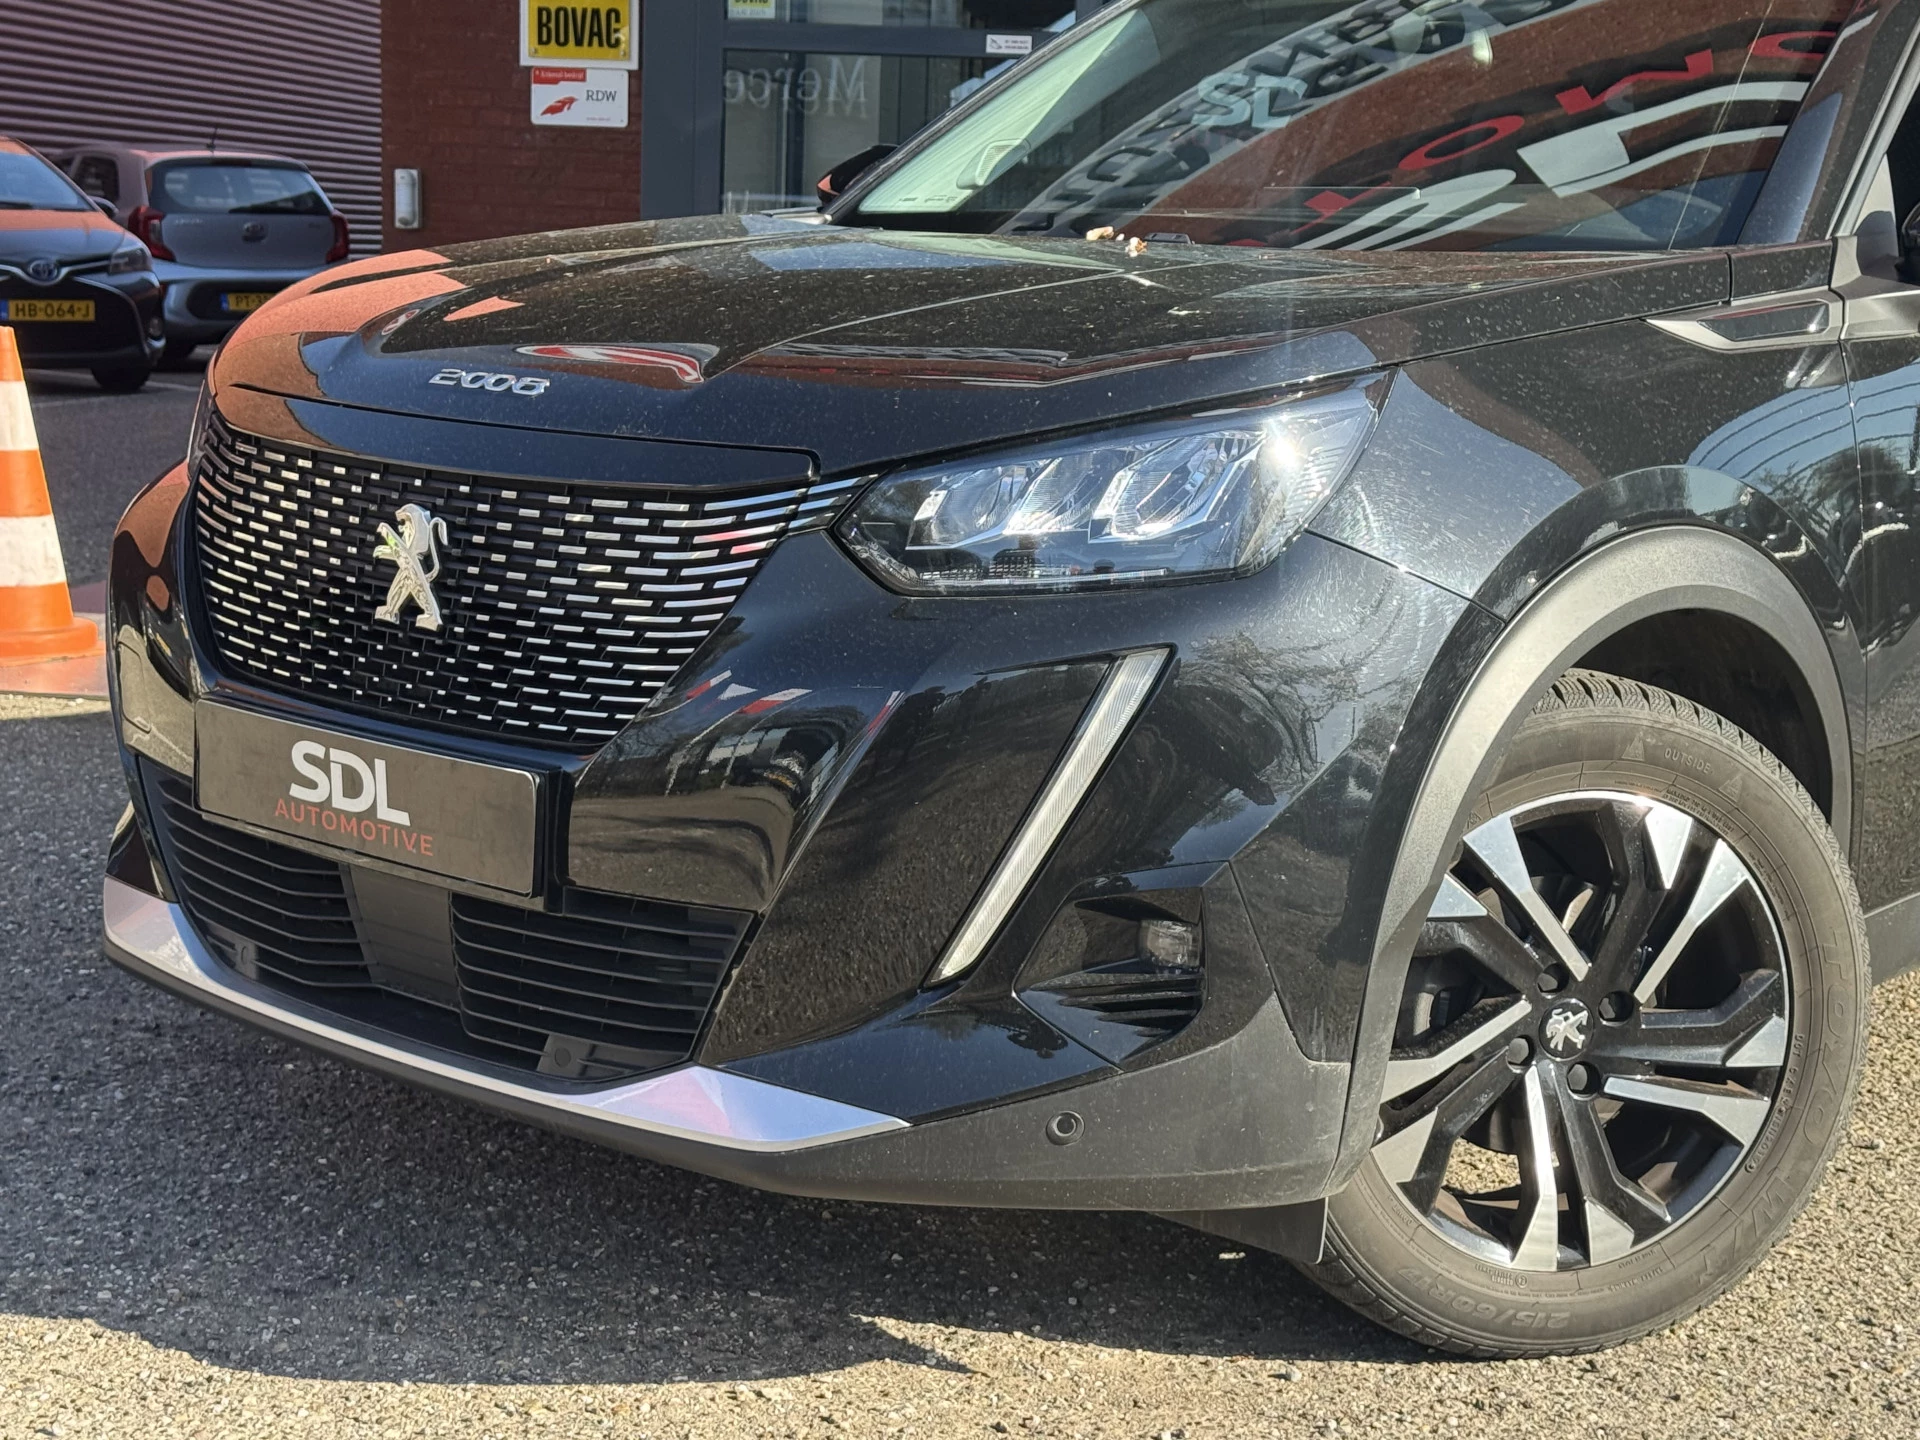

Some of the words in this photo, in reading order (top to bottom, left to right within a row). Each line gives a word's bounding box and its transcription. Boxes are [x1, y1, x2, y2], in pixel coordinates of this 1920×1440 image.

[537, 6, 621, 48] BOVAG
[585, 89, 617, 102] RDW
[15, 302, 91, 318] HB-064-J
[428, 368, 551, 396] 2008
[1664, 747, 1712, 775] OUTSIDE
[288, 739, 411, 827] SDL
[274, 797, 434, 857] AUTOMOTIVE
[1397, 1267, 1572, 1331] 215/60R17
